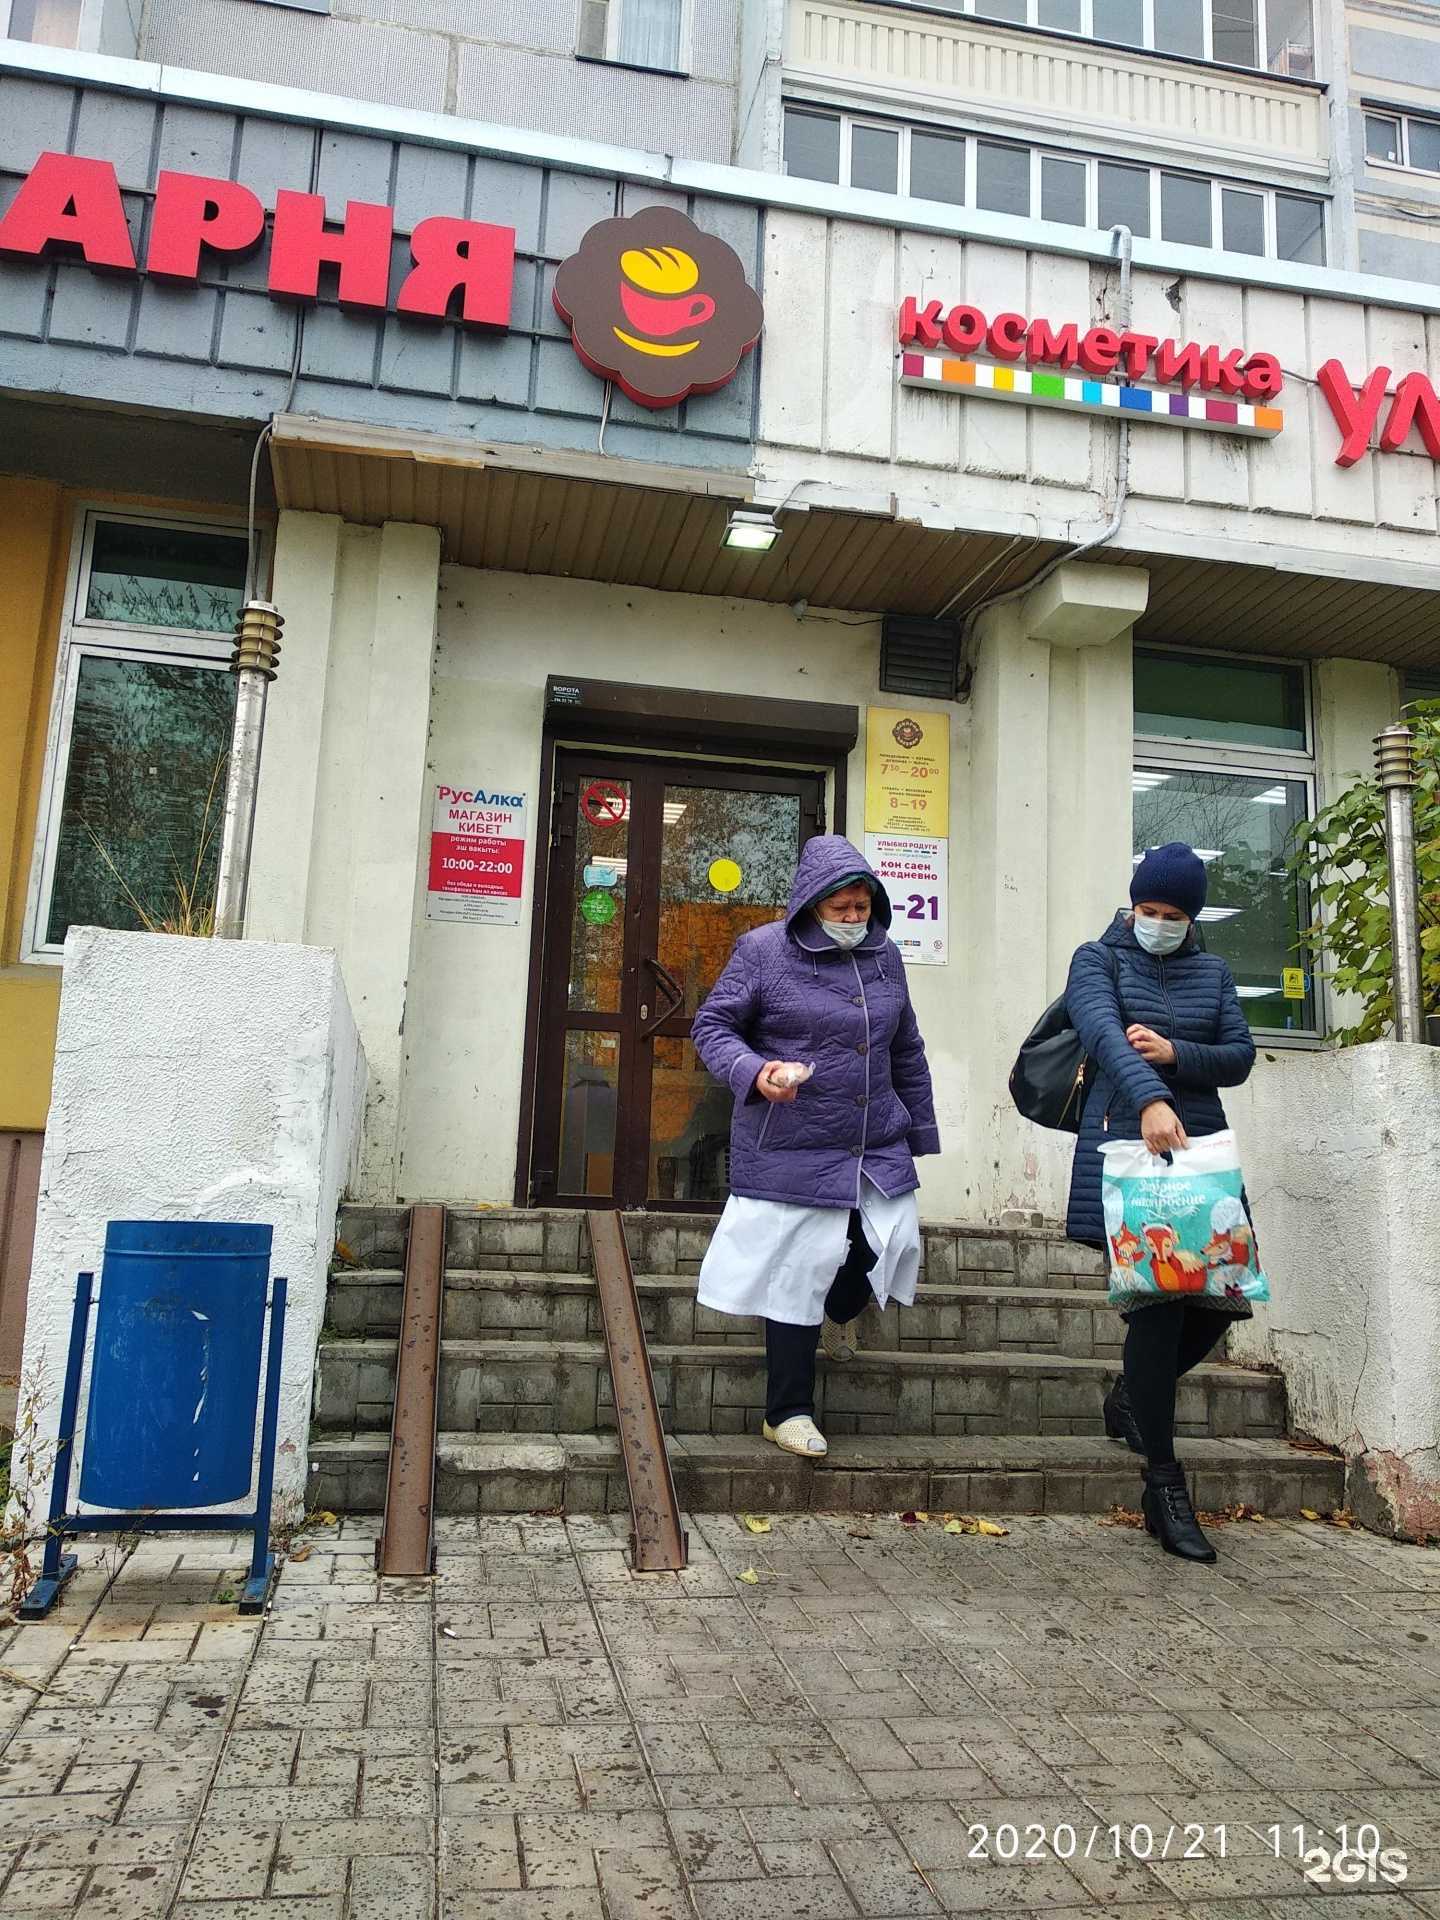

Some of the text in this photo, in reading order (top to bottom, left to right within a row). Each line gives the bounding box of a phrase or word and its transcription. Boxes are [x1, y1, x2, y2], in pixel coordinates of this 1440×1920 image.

[900, 296, 1283, 400] косметика
[448, 809, 512, 823] МАГАЗИН
[458, 822, 502, 835] КИБЕТ
[478, 837, 507, 847] работы
[441, 857, 513, 874] 10:00-22:00
